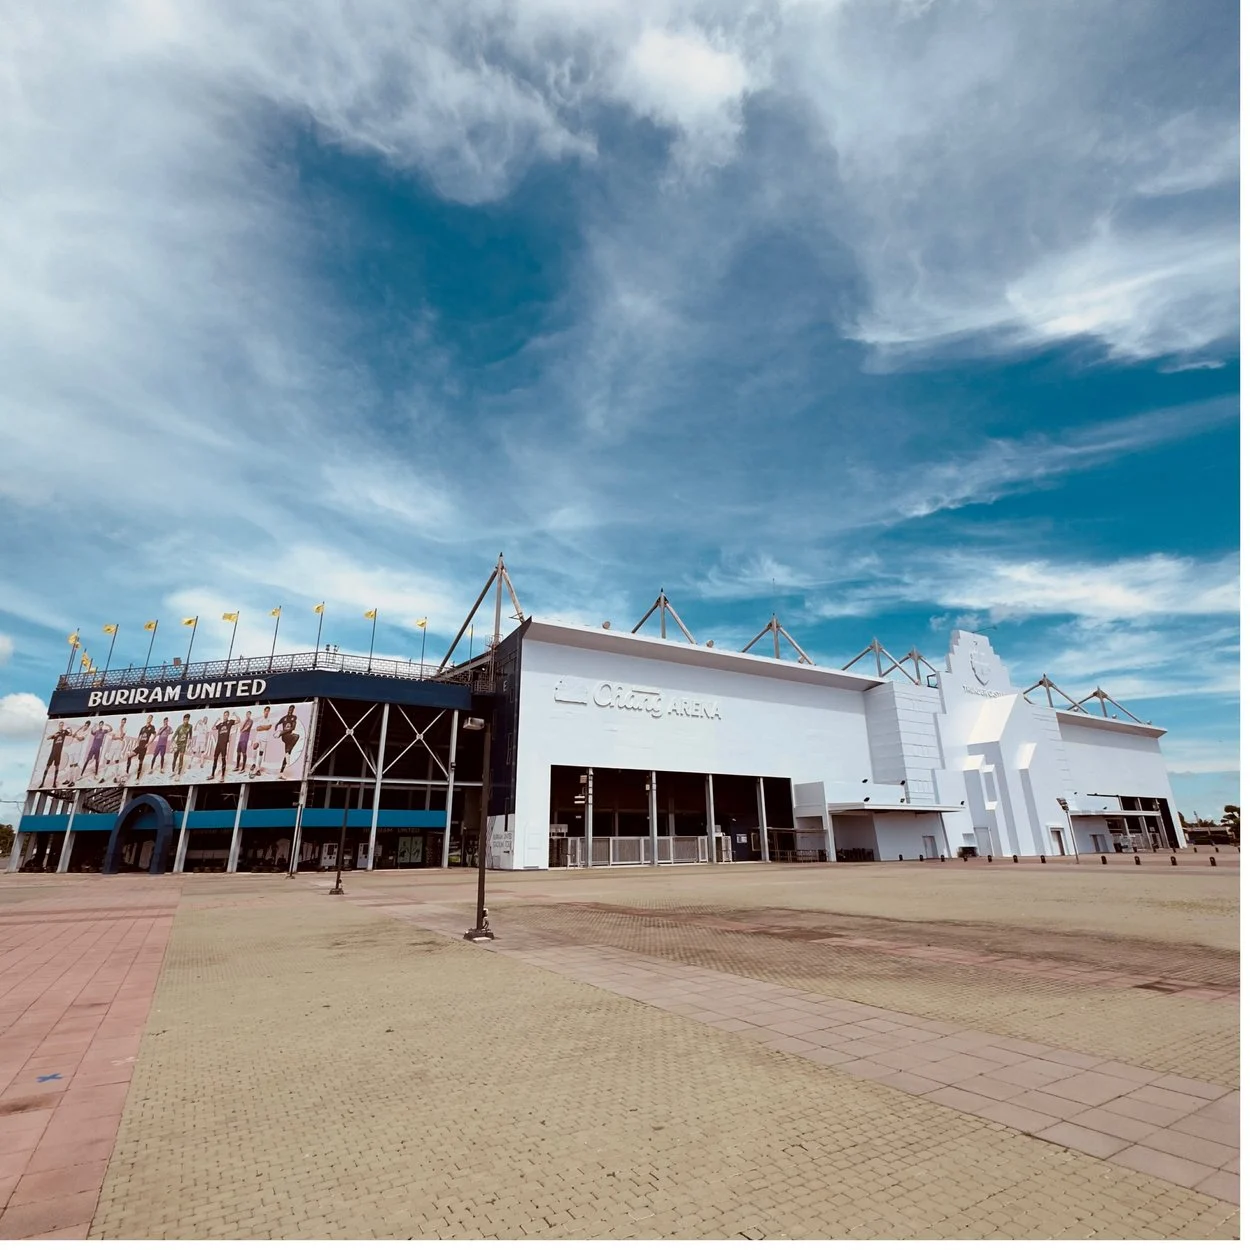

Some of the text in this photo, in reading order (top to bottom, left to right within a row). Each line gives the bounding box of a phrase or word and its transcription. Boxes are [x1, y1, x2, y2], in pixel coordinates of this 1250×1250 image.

[88, 679, 267, 708] BURIRAM UNITED
[668, 697, 723, 721] ARENA
